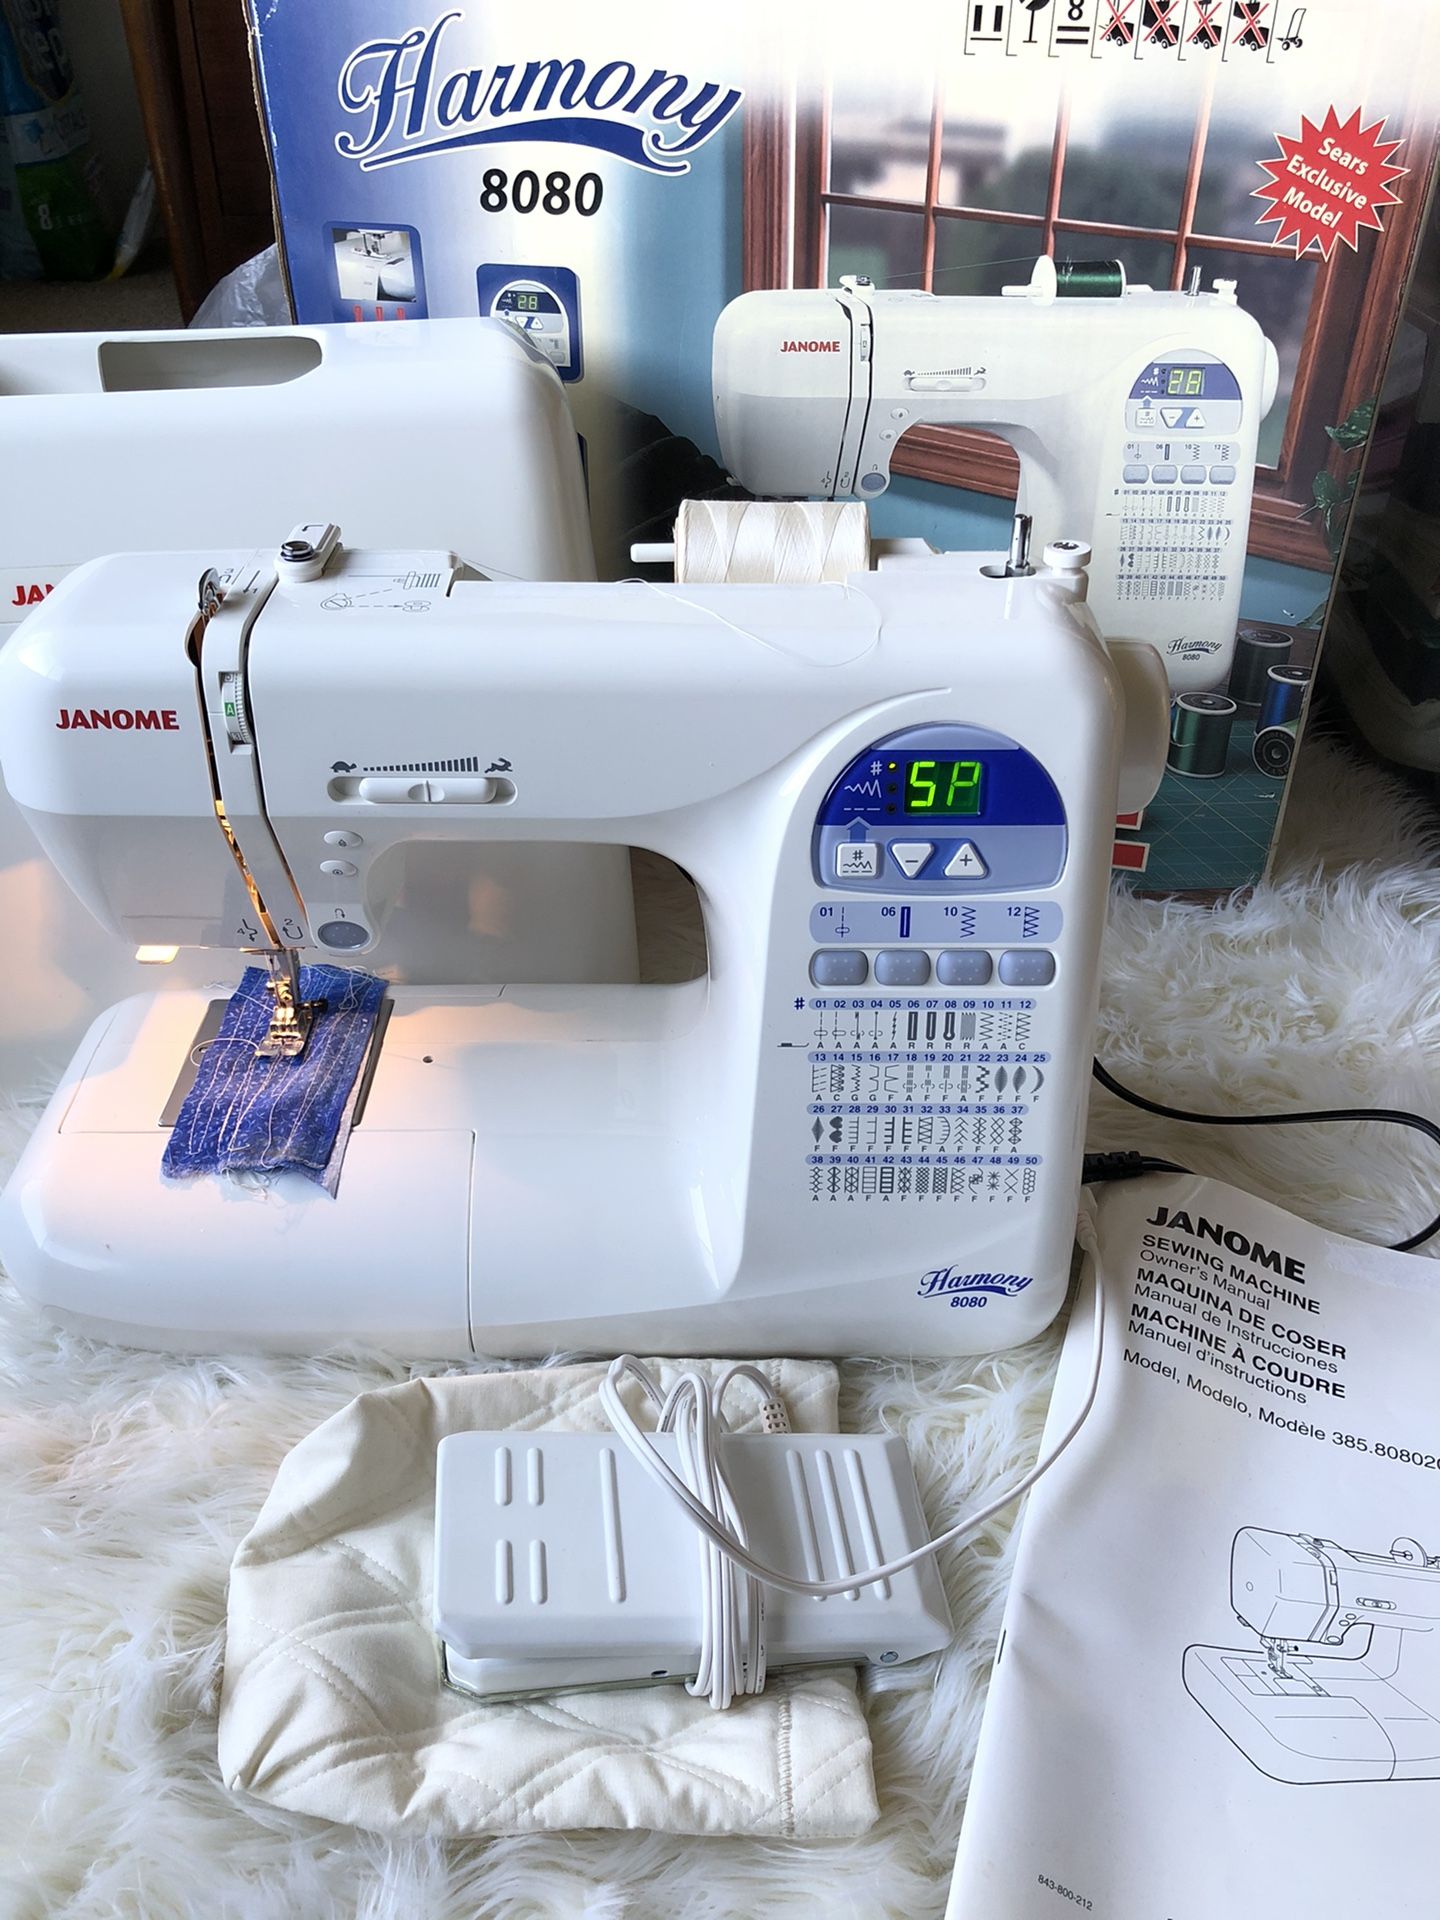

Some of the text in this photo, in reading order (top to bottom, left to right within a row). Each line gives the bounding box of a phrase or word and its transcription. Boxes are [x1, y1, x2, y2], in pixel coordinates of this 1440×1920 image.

[338, 12, 742, 156] Harmony
[1317, 137, 1369, 176] Sears
[480, 168, 603, 216] 8080
[1286, 154, 1368, 210] Exclusive
[1282, 186, 1343, 229] Model
[517, 294, 539, 311] 28
[780, 340, 841, 353] JANOME
[12, 584, 55, 606] JA
[1166, 635, 1223, 655] Harmony
[56, 709, 179, 730] JANOME
[225, 704, 236, 716] A
[819, 906, 1022, 917] 01 06 10 12
[815, 999, 827, 1009] 01
[833, 999, 847, 1009] 02
[852, 999, 865, 1009] 03
[870, 999, 883, 1009] 04
[888, 999, 902, 1009] 05
[907, 999, 920, 1009] 06
[926, 999, 939, 1009] 07
[944, 999, 957, 1009] 08
[962, 1000, 976, 1009] 09
[982, 1000, 995, 1009] 10
[1001, 1000, 1012, 1009] 11
[1020, 1000, 1032, 1009] 12
[814, 1053, 1046, 1063] 13 14 15 16 17 18 19 20 21 22 23 24 25
[812, 1104, 1024, 1114] 26 27 28 29 30 31 32 33 34 35 36 37
[811, 1155, 1038, 1165] 38 39 40 41 42 43 44 45 46 47 48 49 50
[1145, 1206, 1306, 1284] JANOME
[917, 1264, 1034, 1295] Harmony
[1140, 1249, 1270, 1310] Owner's Manual
[1142, 1234, 1321, 1314] SEWING MACHINE
[950, 1296, 988, 1308] 8080
[1137, 1268, 1347, 1360] MAQUINA DE COSER
[1134, 1283, 1338, 1374] Manual de Instrucciones
[1128, 1320, 1307, 1404] Manuel d'instructions
[1131, 1303, 1346, 1399] MACHINE À COUDRE
[1123, 1349, 1181, 1384] Model,
[1186, 1374, 1252, 1418] Modelo,
[1258, 1407, 1326, 1440] Modèle
[1037, 1873, 1094, 1911] 843-800-212
